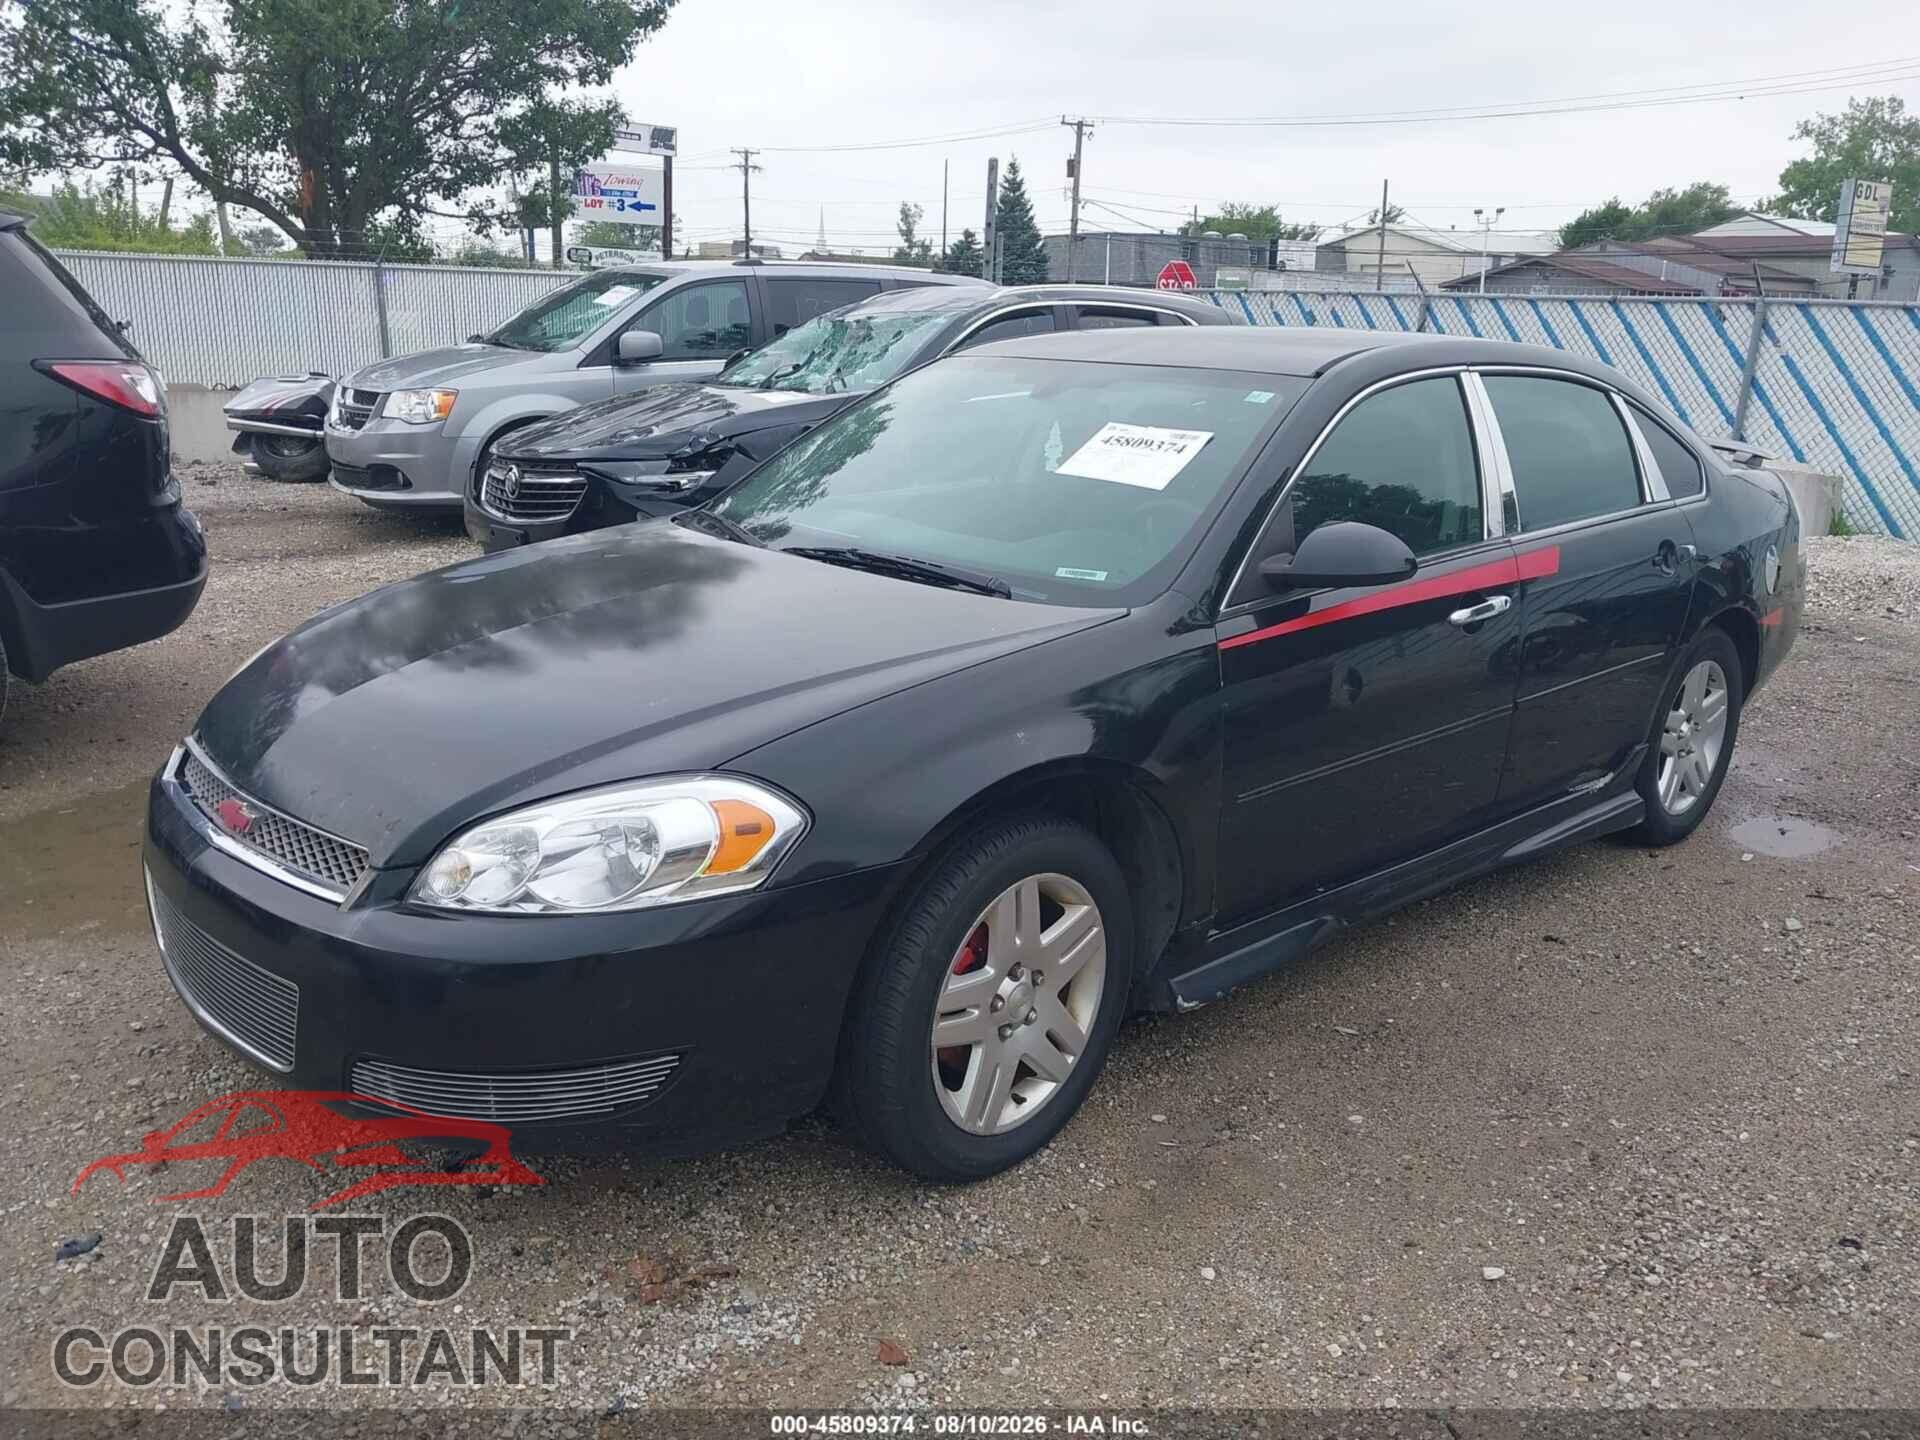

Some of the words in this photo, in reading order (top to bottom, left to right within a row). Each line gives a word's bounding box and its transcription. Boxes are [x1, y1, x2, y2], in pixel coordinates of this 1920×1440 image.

[603, 174, 642, 189] Towing
[584, 198, 604, 208] LOT
[608, 198, 626, 212] #3
[1101, 434, 1188, 455] 45809374
